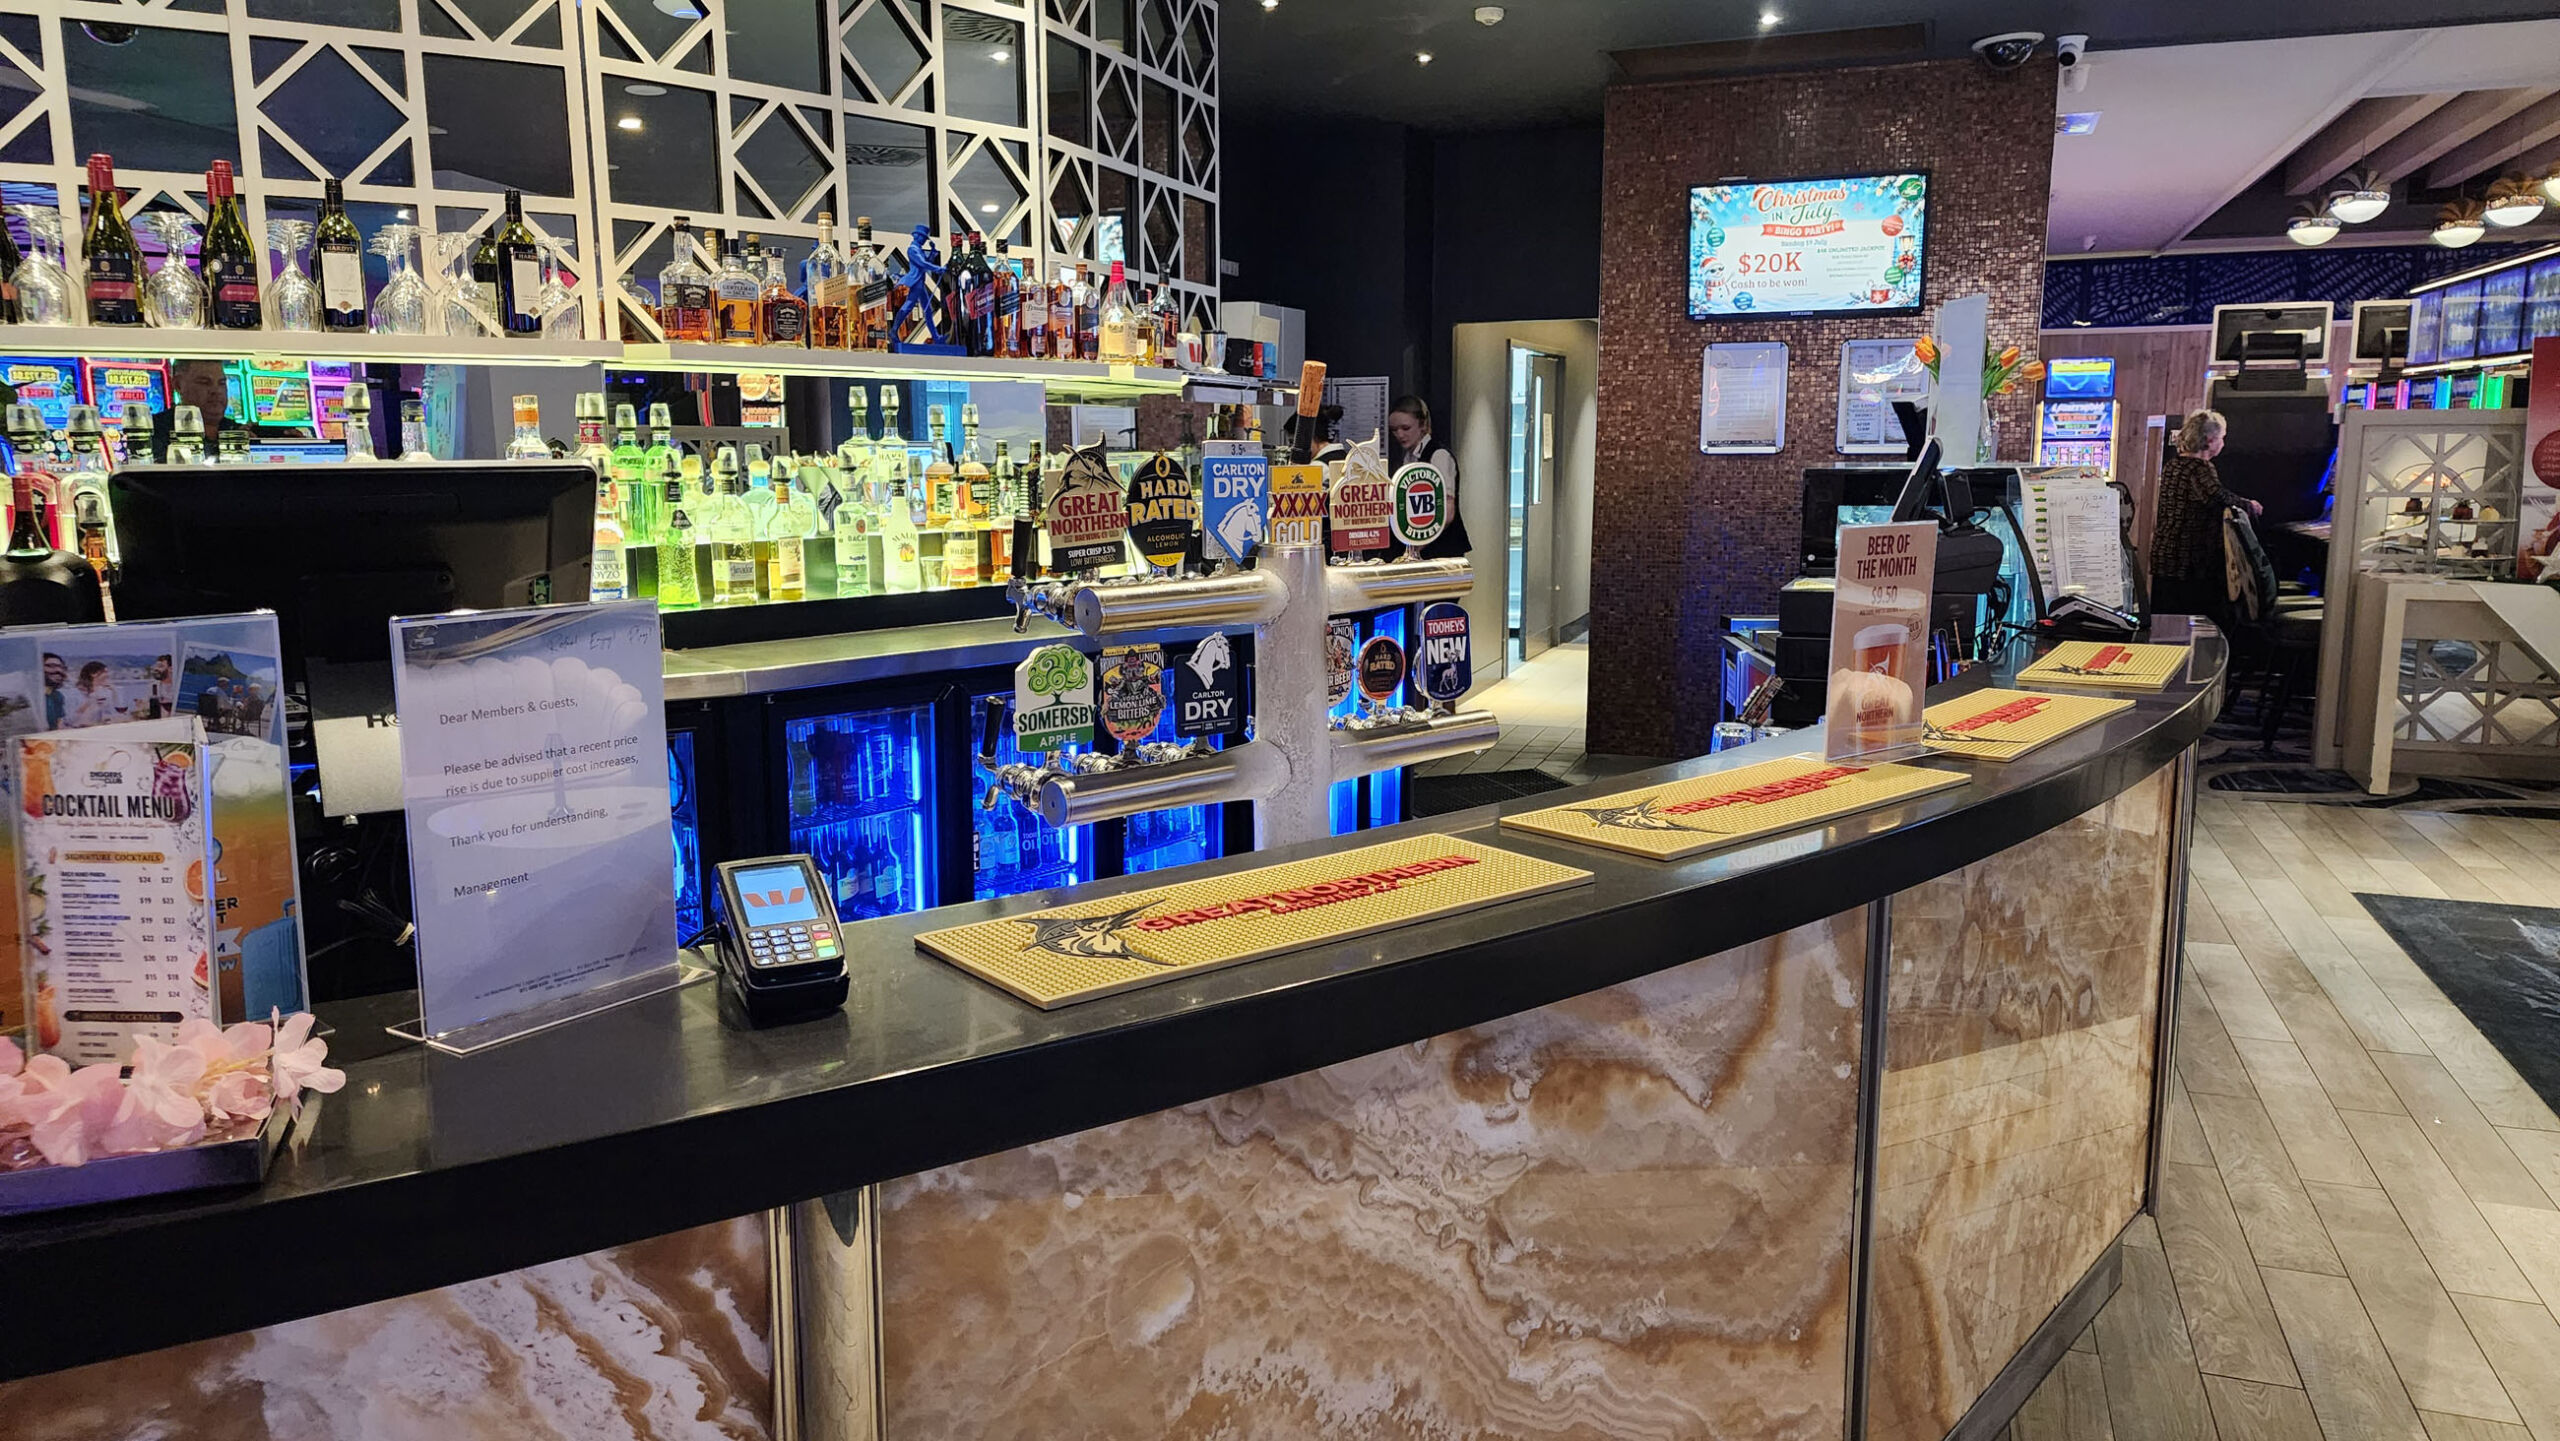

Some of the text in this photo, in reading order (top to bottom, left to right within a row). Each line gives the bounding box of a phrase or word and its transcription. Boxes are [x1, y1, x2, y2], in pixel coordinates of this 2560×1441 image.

[1752, 186, 1846, 212] Christmas
[1771, 201, 1839, 225] IN July
[1775, 224, 1835, 238] BINGO PARTY!
[1738, 252, 1802, 275] $20K
[1757, 279, 1768, 288] to
[1770, 278, 1781, 288] be
[1783, 278, 1808, 288] won!
[1212, 463, 1265, 476] CARLTON
[1400, 469, 1441, 490] VICTORIA
[1140, 478, 1191, 499] HARD
[1214, 477, 1265, 498] DRY
[1340, 483, 1387, 503] GREAT
[1057, 491, 1119, 518] GREAT
[1127, 498, 1200, 527] RATED
[1271, 492, 1328, 518] XXXX
[1334, 501, 1394, 519] NORTHERN
[1408, 493, 1435, 514] VB
[1051, 511, 1129, 537] NORTHERN
[1276, 521, 1320, 544] GOLD
[1405, 522, 1441, 539] BITTER
[1074, 533, 1101, 543] BREWING
[1147, 533, 1186, 543] ALCOHOLIC
[1155, 541, 1179, 549] LEMON
[1867, 533, 1911, 556] BEER OF
[1068, 544, 1116, 559] SUPER CRISP 3.5%
[1070, 557, 1083, 567] LOW
[1856, 556, 1917, 580] THE MONTH
[1871, 585, 1898, 605] $9.50
[1332, 625, 1355, 643] UNION
[1427, 620, 1465, 635] TOOHEYS
[1139, 651, 1165, 669] UNION
[1426, 636, 1467, 665] NEW
[1369, 660, 1396, 672] RATED
[1334, 671, 1351, 685] BEER
[1109, 696, 1158, 710] LEMON LIME
[1192, 689, 1225, 700] CARLTON
[439, 697, 578, 726] Dear Members & Guests,
[1018, 703, 1097, 733] SOMERSBY
[1117, 707, 1150, 720] BITTERS
[1184, 697, 1233, 721] DRY
[1856, 706, 1894, 724] NORTHERN
[1039, 732, 1077, 748] APPLE
[444, 734, 639, 776] Please be advised that a recent price
[446, 754, 639, 798] rise is due to supplier cost increases,
[42, 794, 175, 819] COCKTAIL MENU
[450, 807, 609, 848] Thank you for understanding,
[65, 853, 161, 862] SIGNATURE COCKTAILS
[453, 872, 529, 898] Management
[1136, 854, 1480, 932] GREAT NORTHERN
